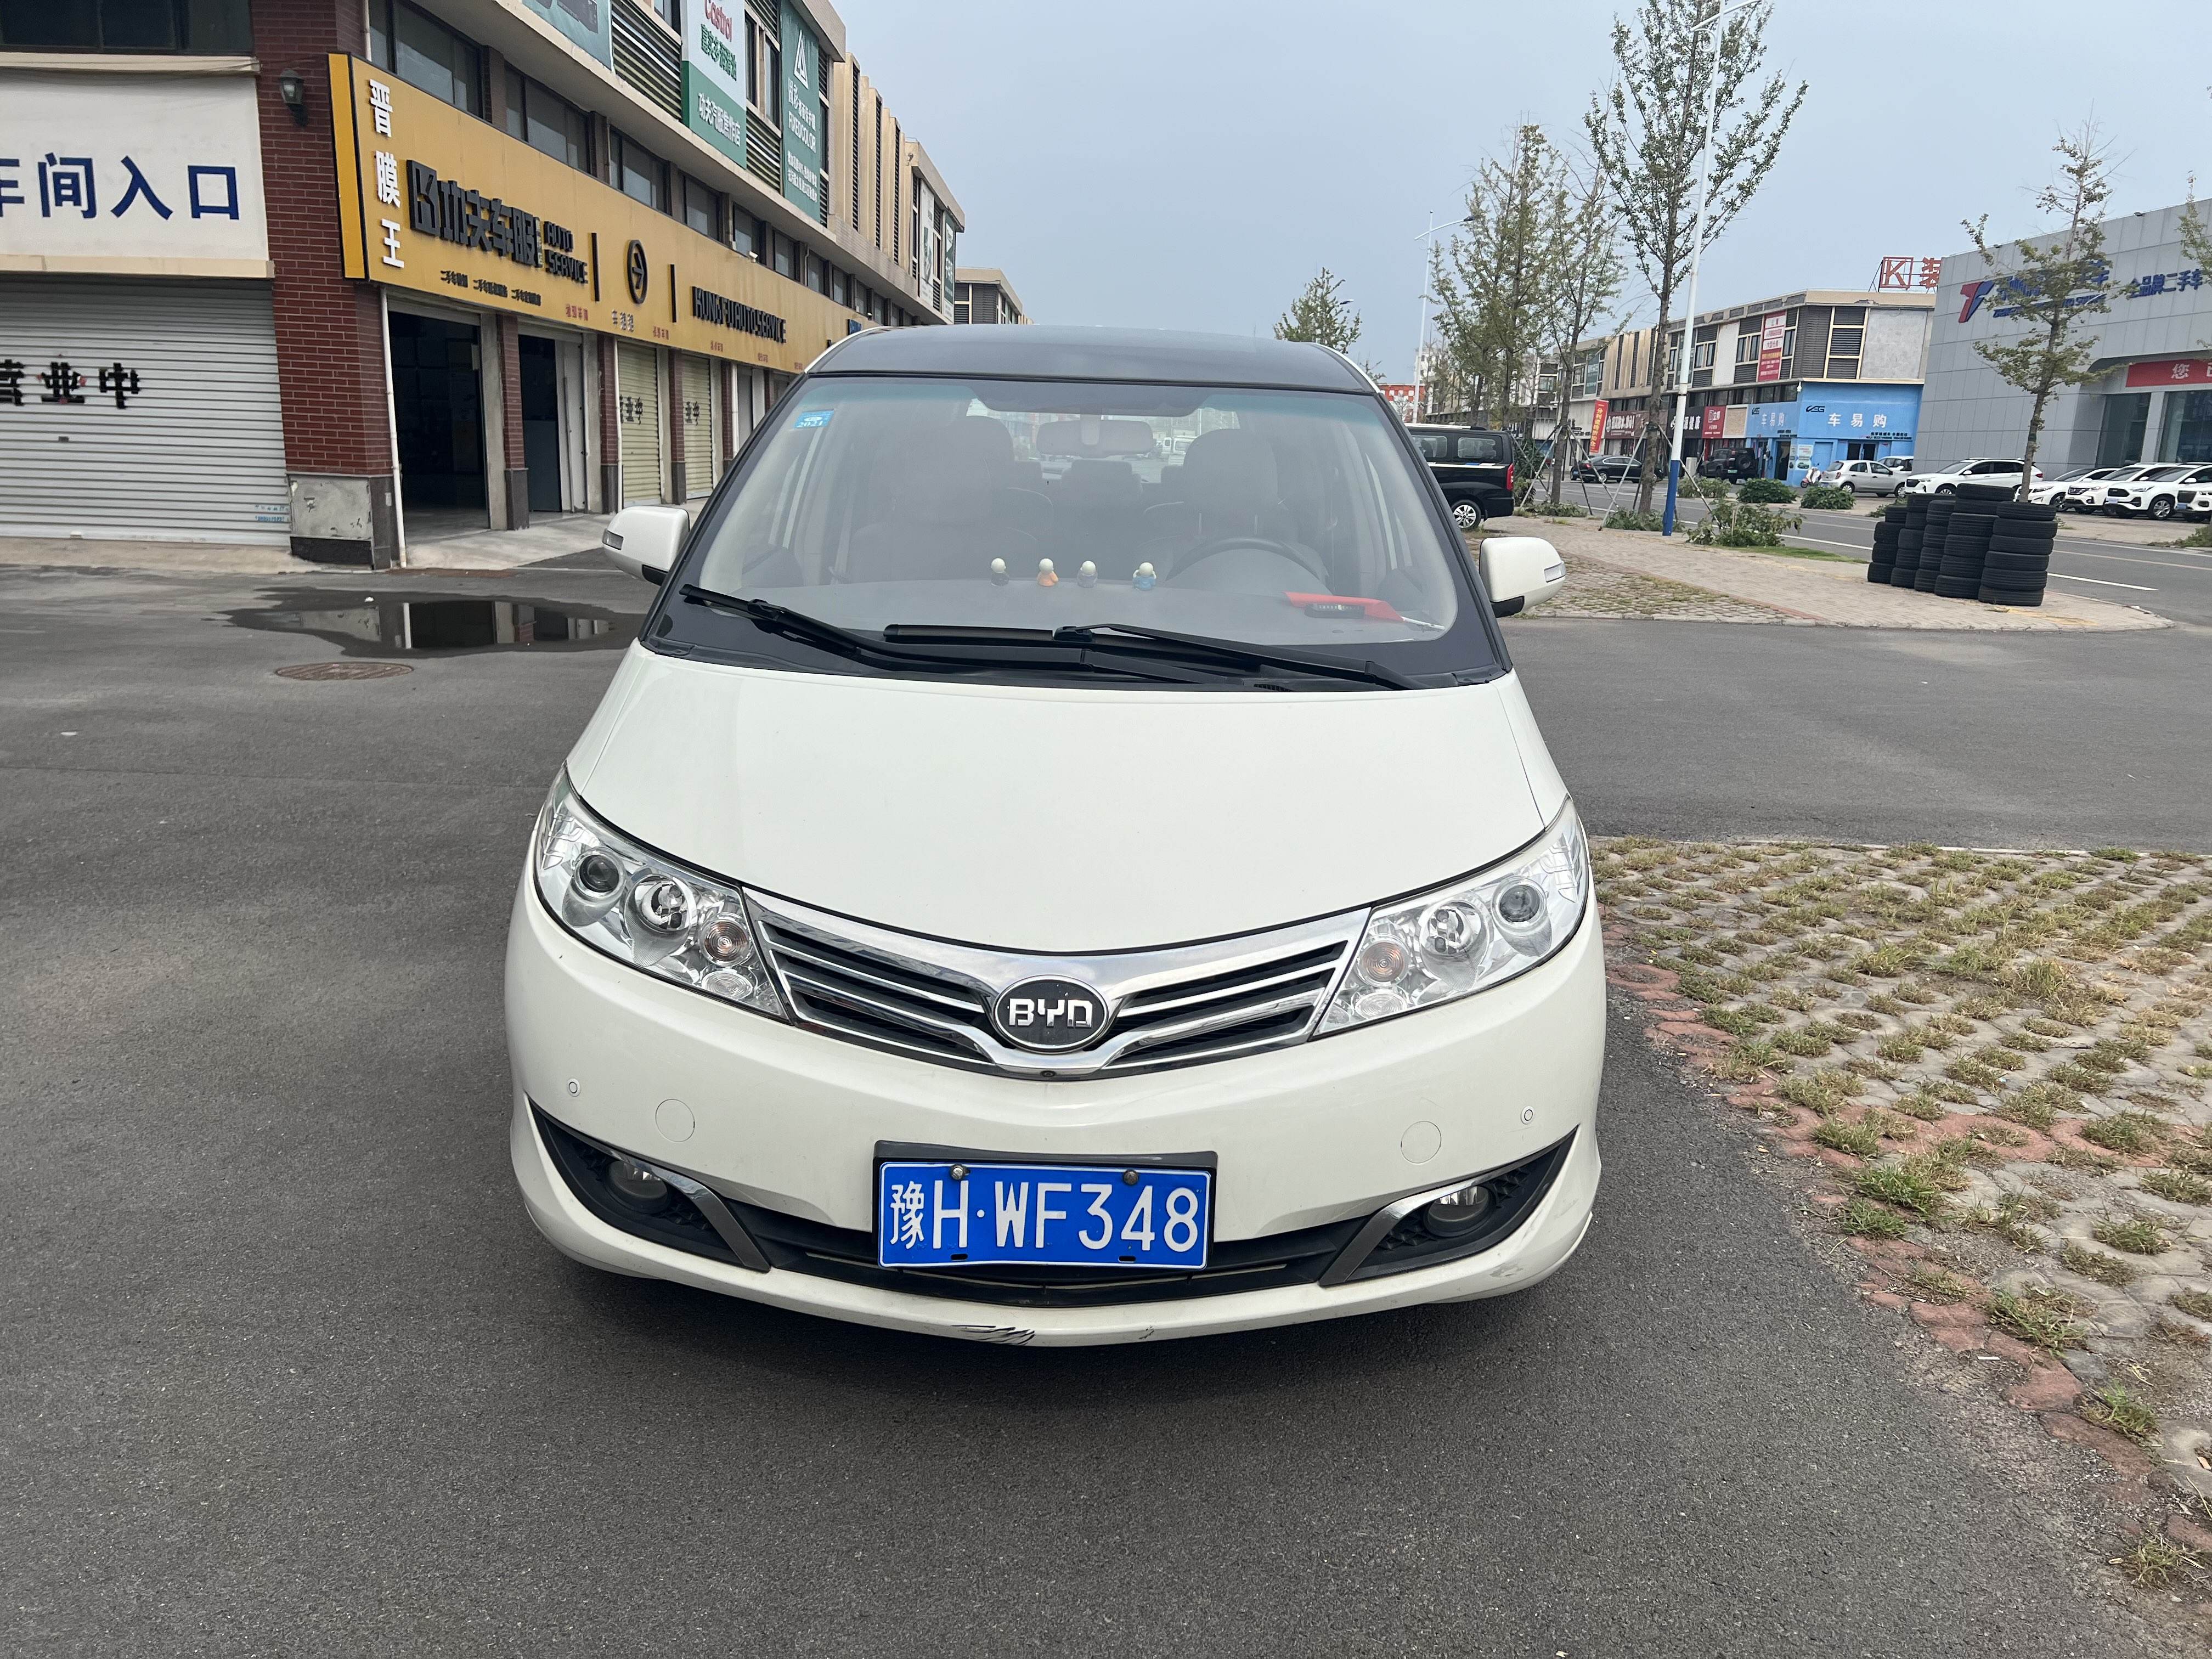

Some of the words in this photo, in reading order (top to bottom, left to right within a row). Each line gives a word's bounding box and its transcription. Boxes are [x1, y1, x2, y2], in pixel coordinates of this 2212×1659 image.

[705, 0, 732, 42] Castrol
[369, 78, 405, 269] 晋膜王
[544, 221, 574, 253] AUTO
[544, 249, 589, 284] SERVICE
[1760, 412, 1786, 427] 车易购
[1827, 413, 1887, 428] 车易购
[1009, 998, 1093, 1028] BYD
[889, 1179, 1198, 1253] 豫H·WF348
